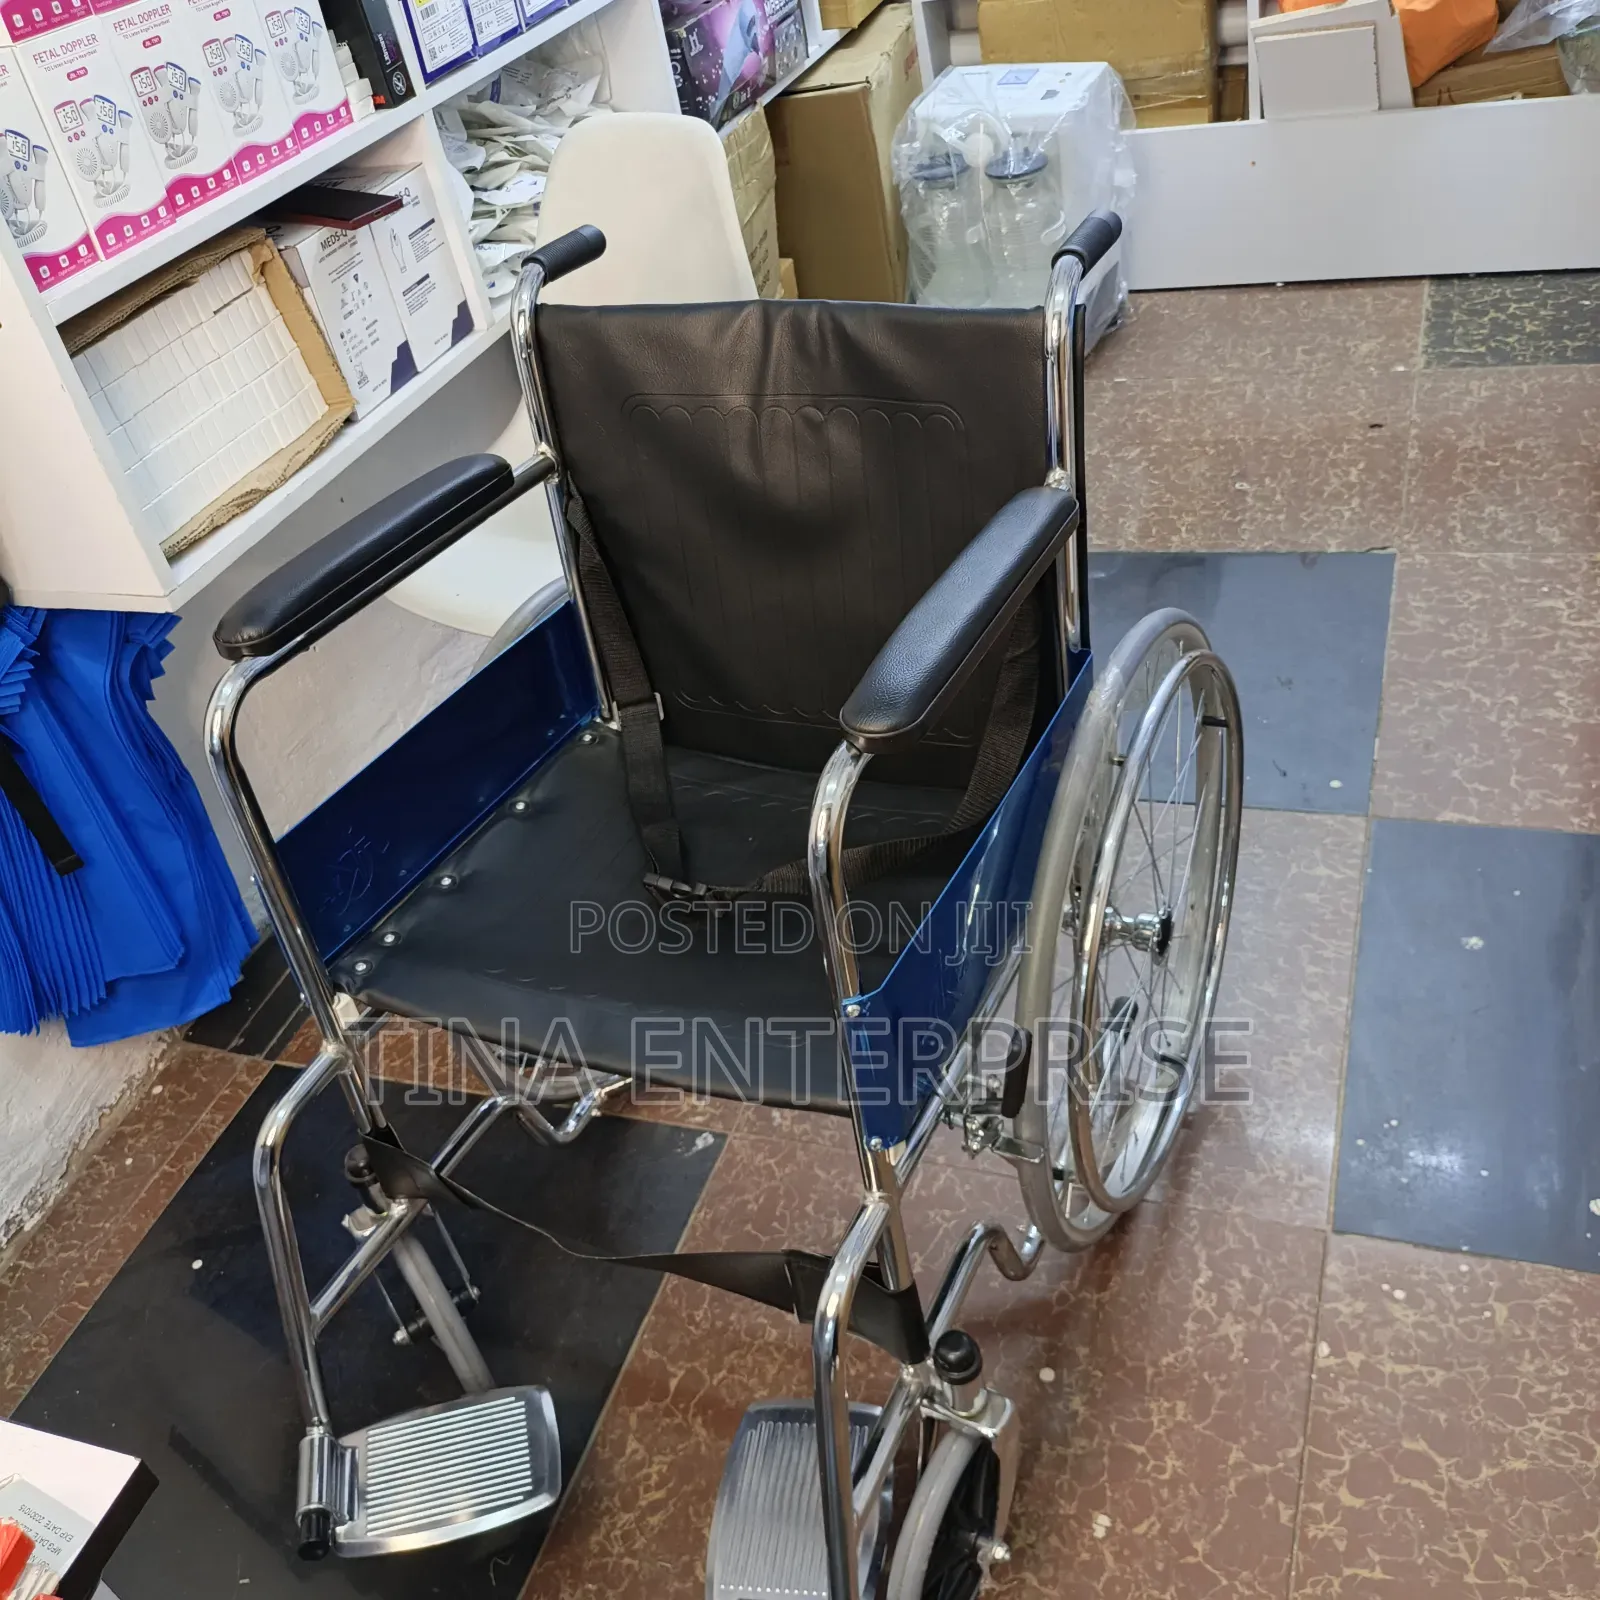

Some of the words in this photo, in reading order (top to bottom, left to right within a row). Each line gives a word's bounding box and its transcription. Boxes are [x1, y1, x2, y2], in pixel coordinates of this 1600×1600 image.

[112, 15, 138, 33] FETAL
[138, 4, 172, 24] DOPPLER
[272, 19, 283, 32] 150
[298, 15, 308, 29] 150
[32, 48, 61, 64] FETAL
[60, 34, 99, 55] DOPPLER
[210, 47, 222, 60] 150
[240, 44, 250, 56] 150
[139, 76, 152, 89] 150
[172, 72, 184, 85] 150
[63, 110, 78, 124] 150
[100, 105, 113, 119] 150
[12, 140, 26, 155] 150
[320, 229, 348, 251] MEDS-Q
[44, 1520, 62, 1535] DATE
[33, 1532, 49, 1547] DATE
[59, 1532, 74, 1542] EXP
[47, 1542, 62, 1555] MFG
